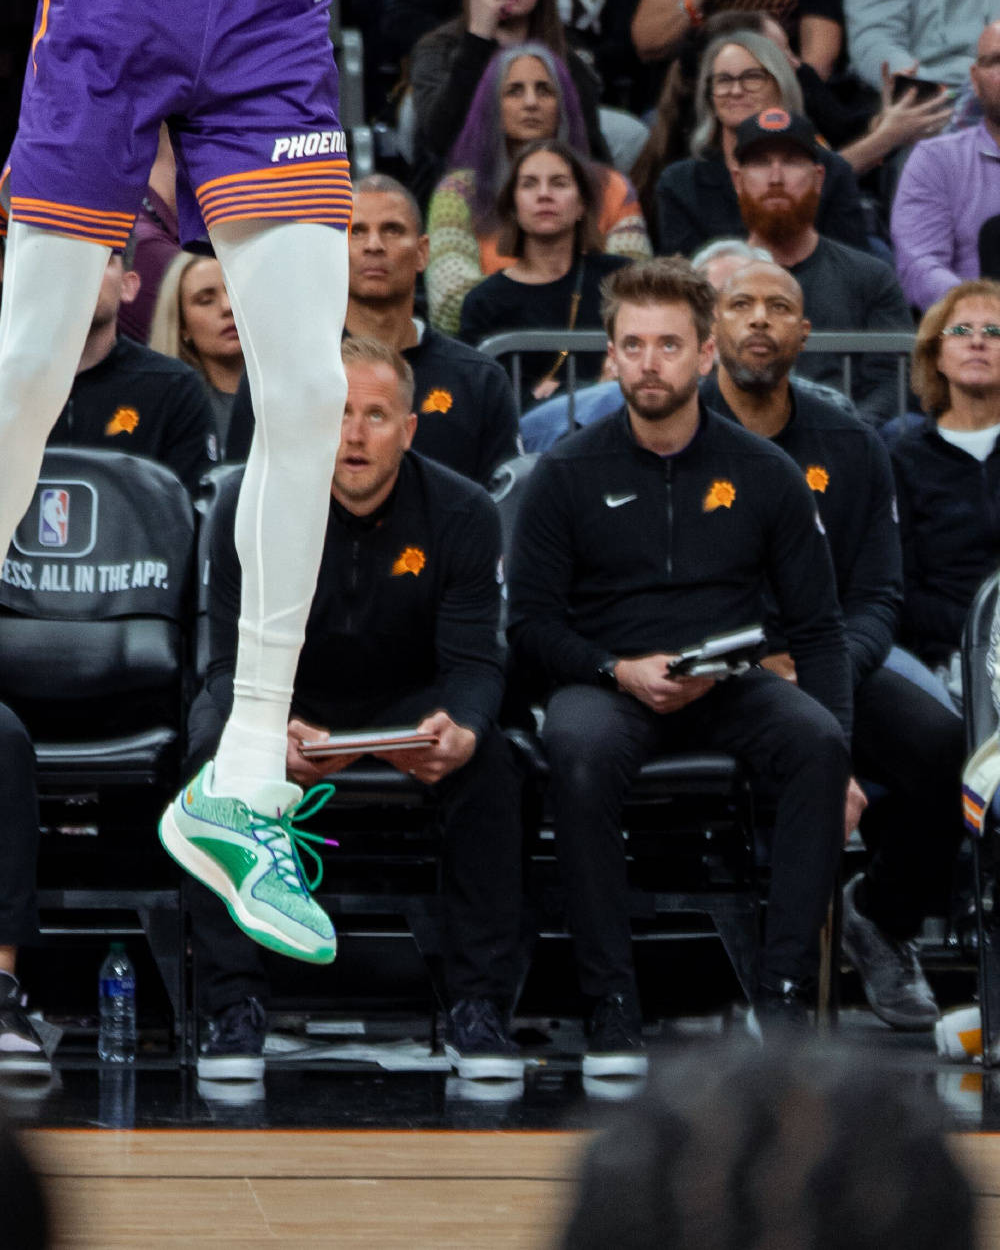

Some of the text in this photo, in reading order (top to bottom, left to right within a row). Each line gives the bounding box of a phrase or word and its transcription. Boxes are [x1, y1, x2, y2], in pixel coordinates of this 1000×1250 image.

[271, 131, 348, 162] PHOENI
[2, 558, 169, 593] ESS. ALL IN THE APP.
